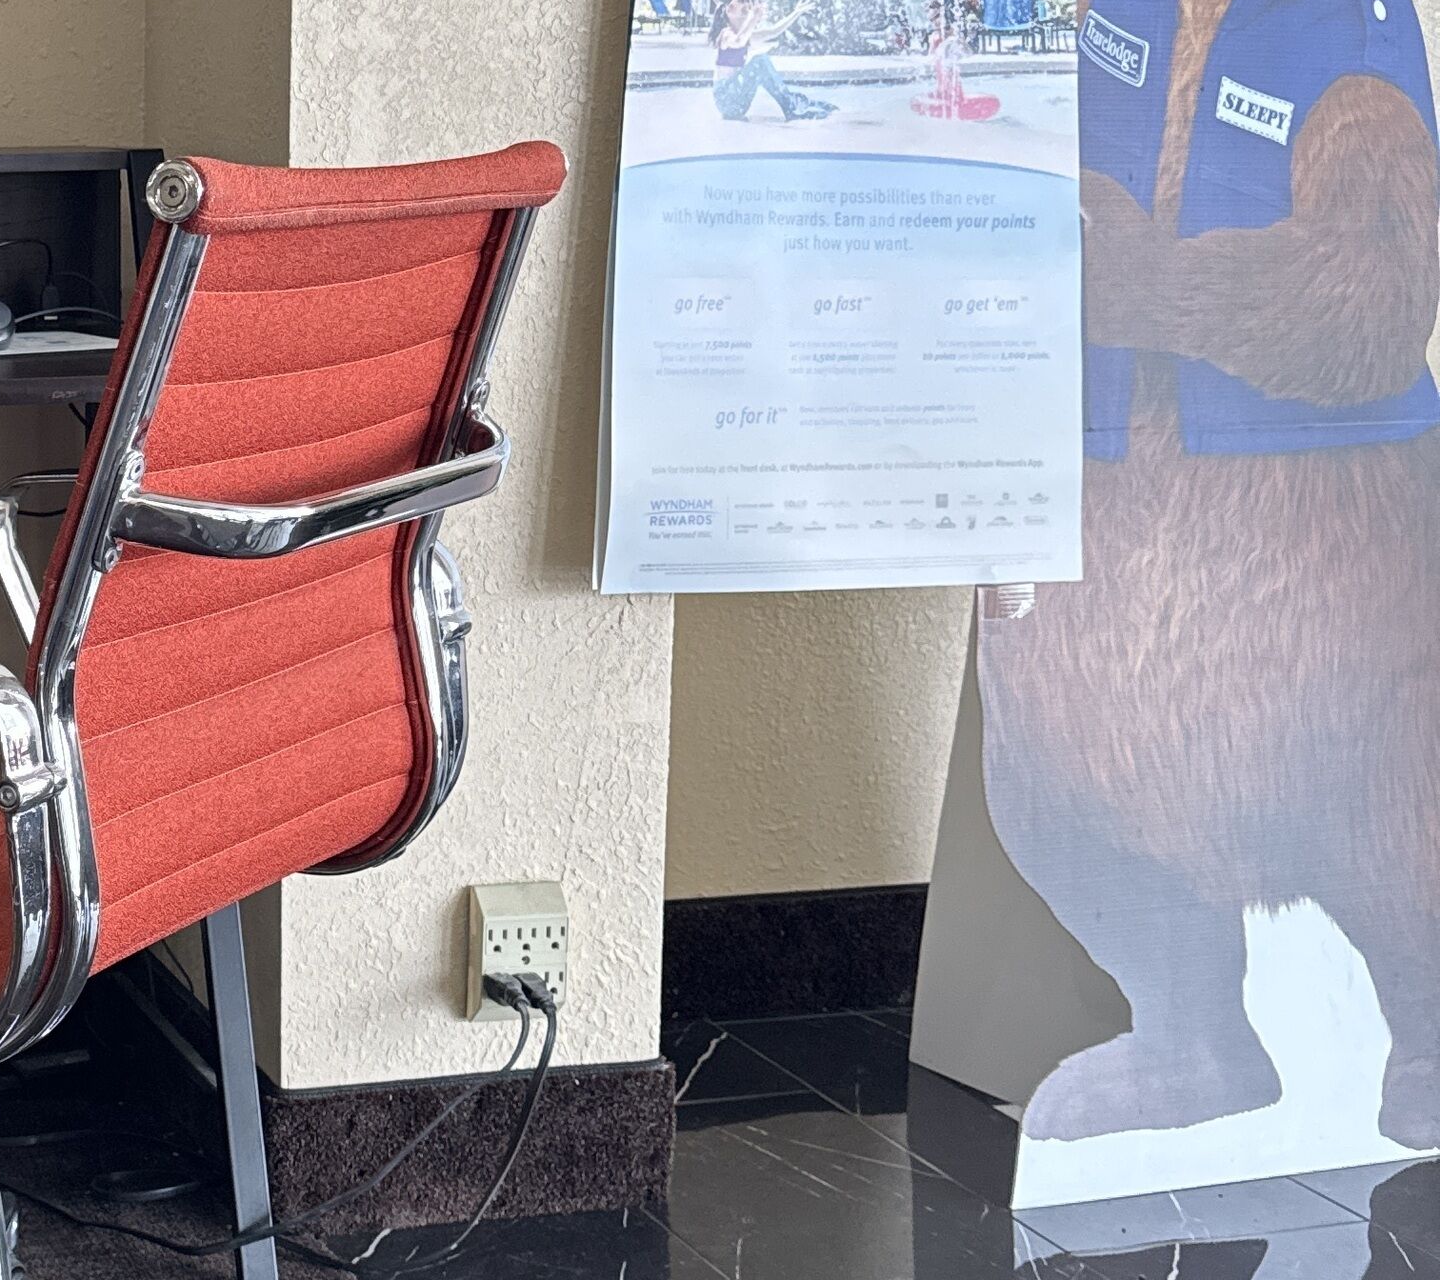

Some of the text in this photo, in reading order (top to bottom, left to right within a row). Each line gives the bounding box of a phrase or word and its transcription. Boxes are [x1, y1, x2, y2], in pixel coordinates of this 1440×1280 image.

[1085, 17, 1139, 72] Travelodge
[1222, 92, 1289, 130] SLEEPY
[704, 184, 996, 206] Now you have more possibilities than ever
[662, 207, 1036, 232] with Wyndham Rewards. Earn and redeem your points
[783, 234, 914, 254] just how you want.
[674, 297, 693, 315] go
[813, 297, 832, 315] go
[944, 297, 963, 315] go
[966, 296, 990, 315] get
[715, 408, 735, 429] go
[739, 407, 763, 428] for
[649, 498, 713, 511] WYNDHAM
[649, 514, 713, 527] REWARDS
